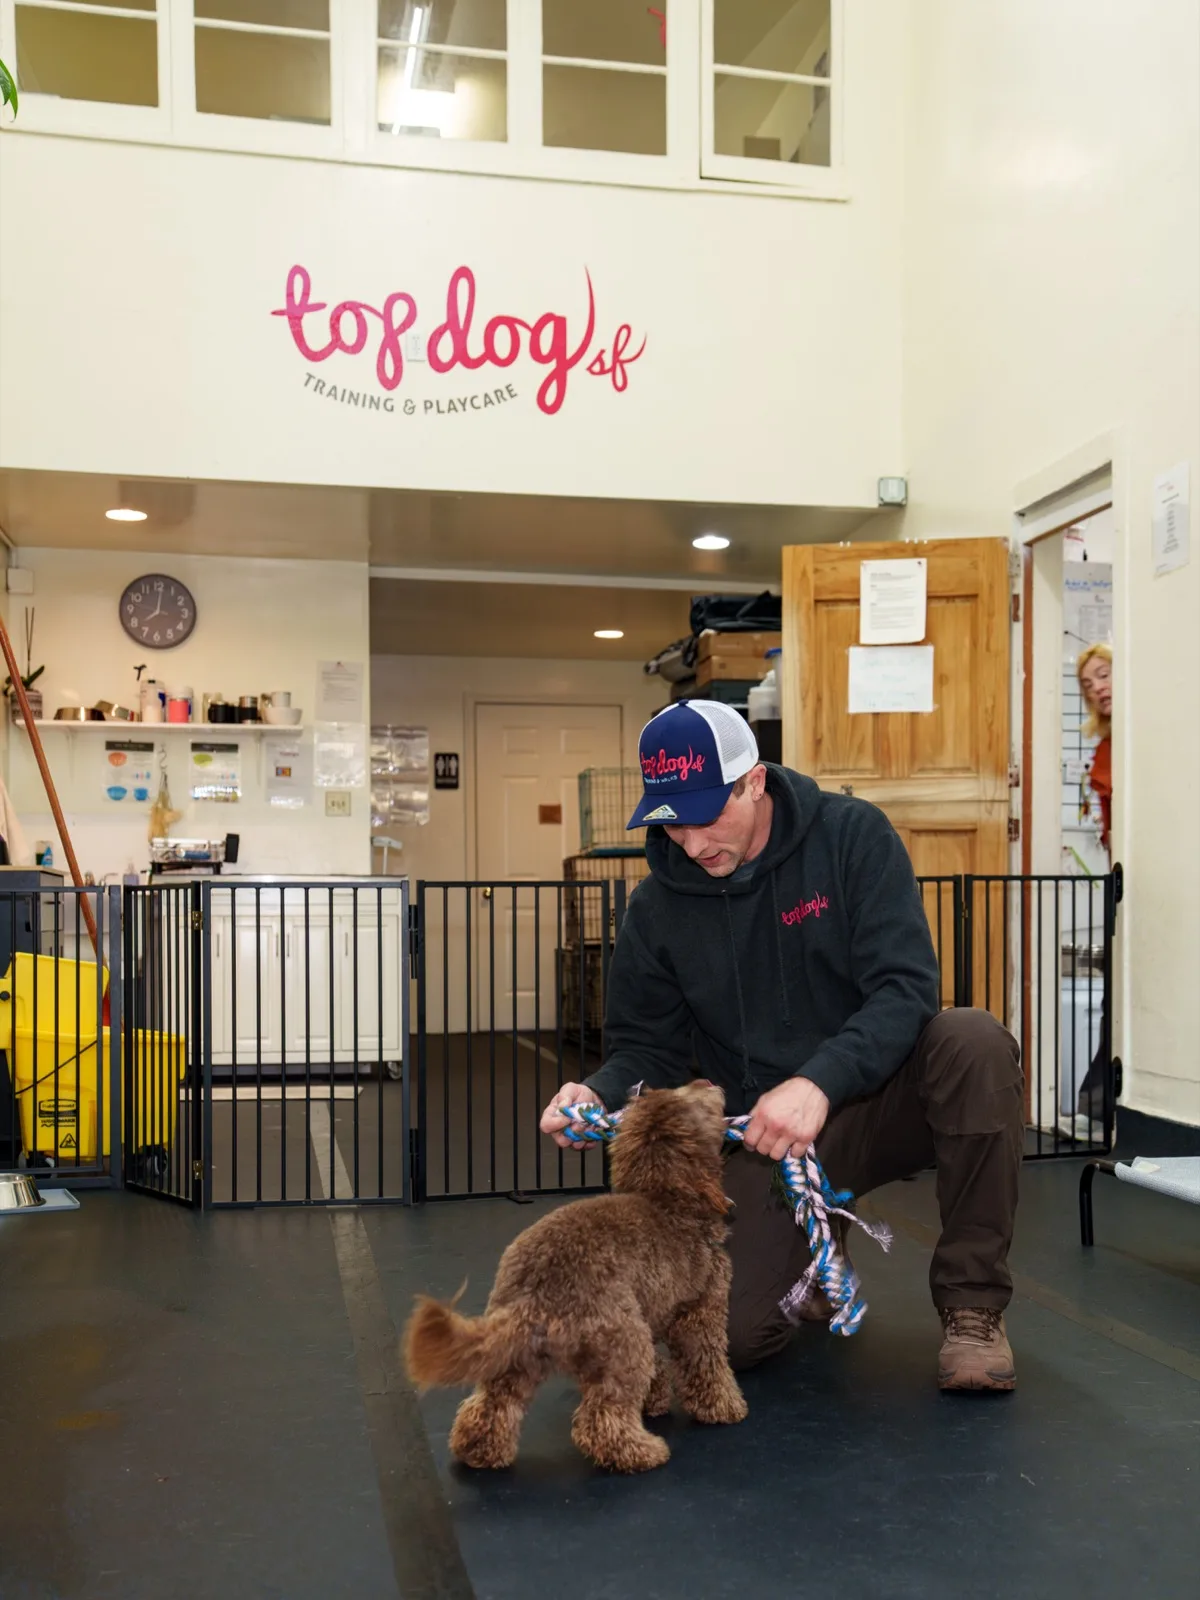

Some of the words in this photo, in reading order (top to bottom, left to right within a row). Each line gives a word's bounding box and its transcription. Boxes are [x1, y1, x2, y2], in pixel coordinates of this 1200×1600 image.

[303, 372, 395, 413] TRAINING
[403, 395, 417, 415] &
[424, 383, 518, 414] PLAYCARE
[141, 584, 150, 594] 11
[153, 580, 165, 592] 12
[131, 592, 142, 603] 10
[177, 595, 184, 606] 2
[126, 604, 134, 614] 9
[181, 608, 189, 619] 3
[130, 617, 138, 628] 8
[176, 621, 184, 631] 4
[141, 626, 149, 638] 7
[153, 630, 160, 641] 6
[166, 628, 174, 639] 5
